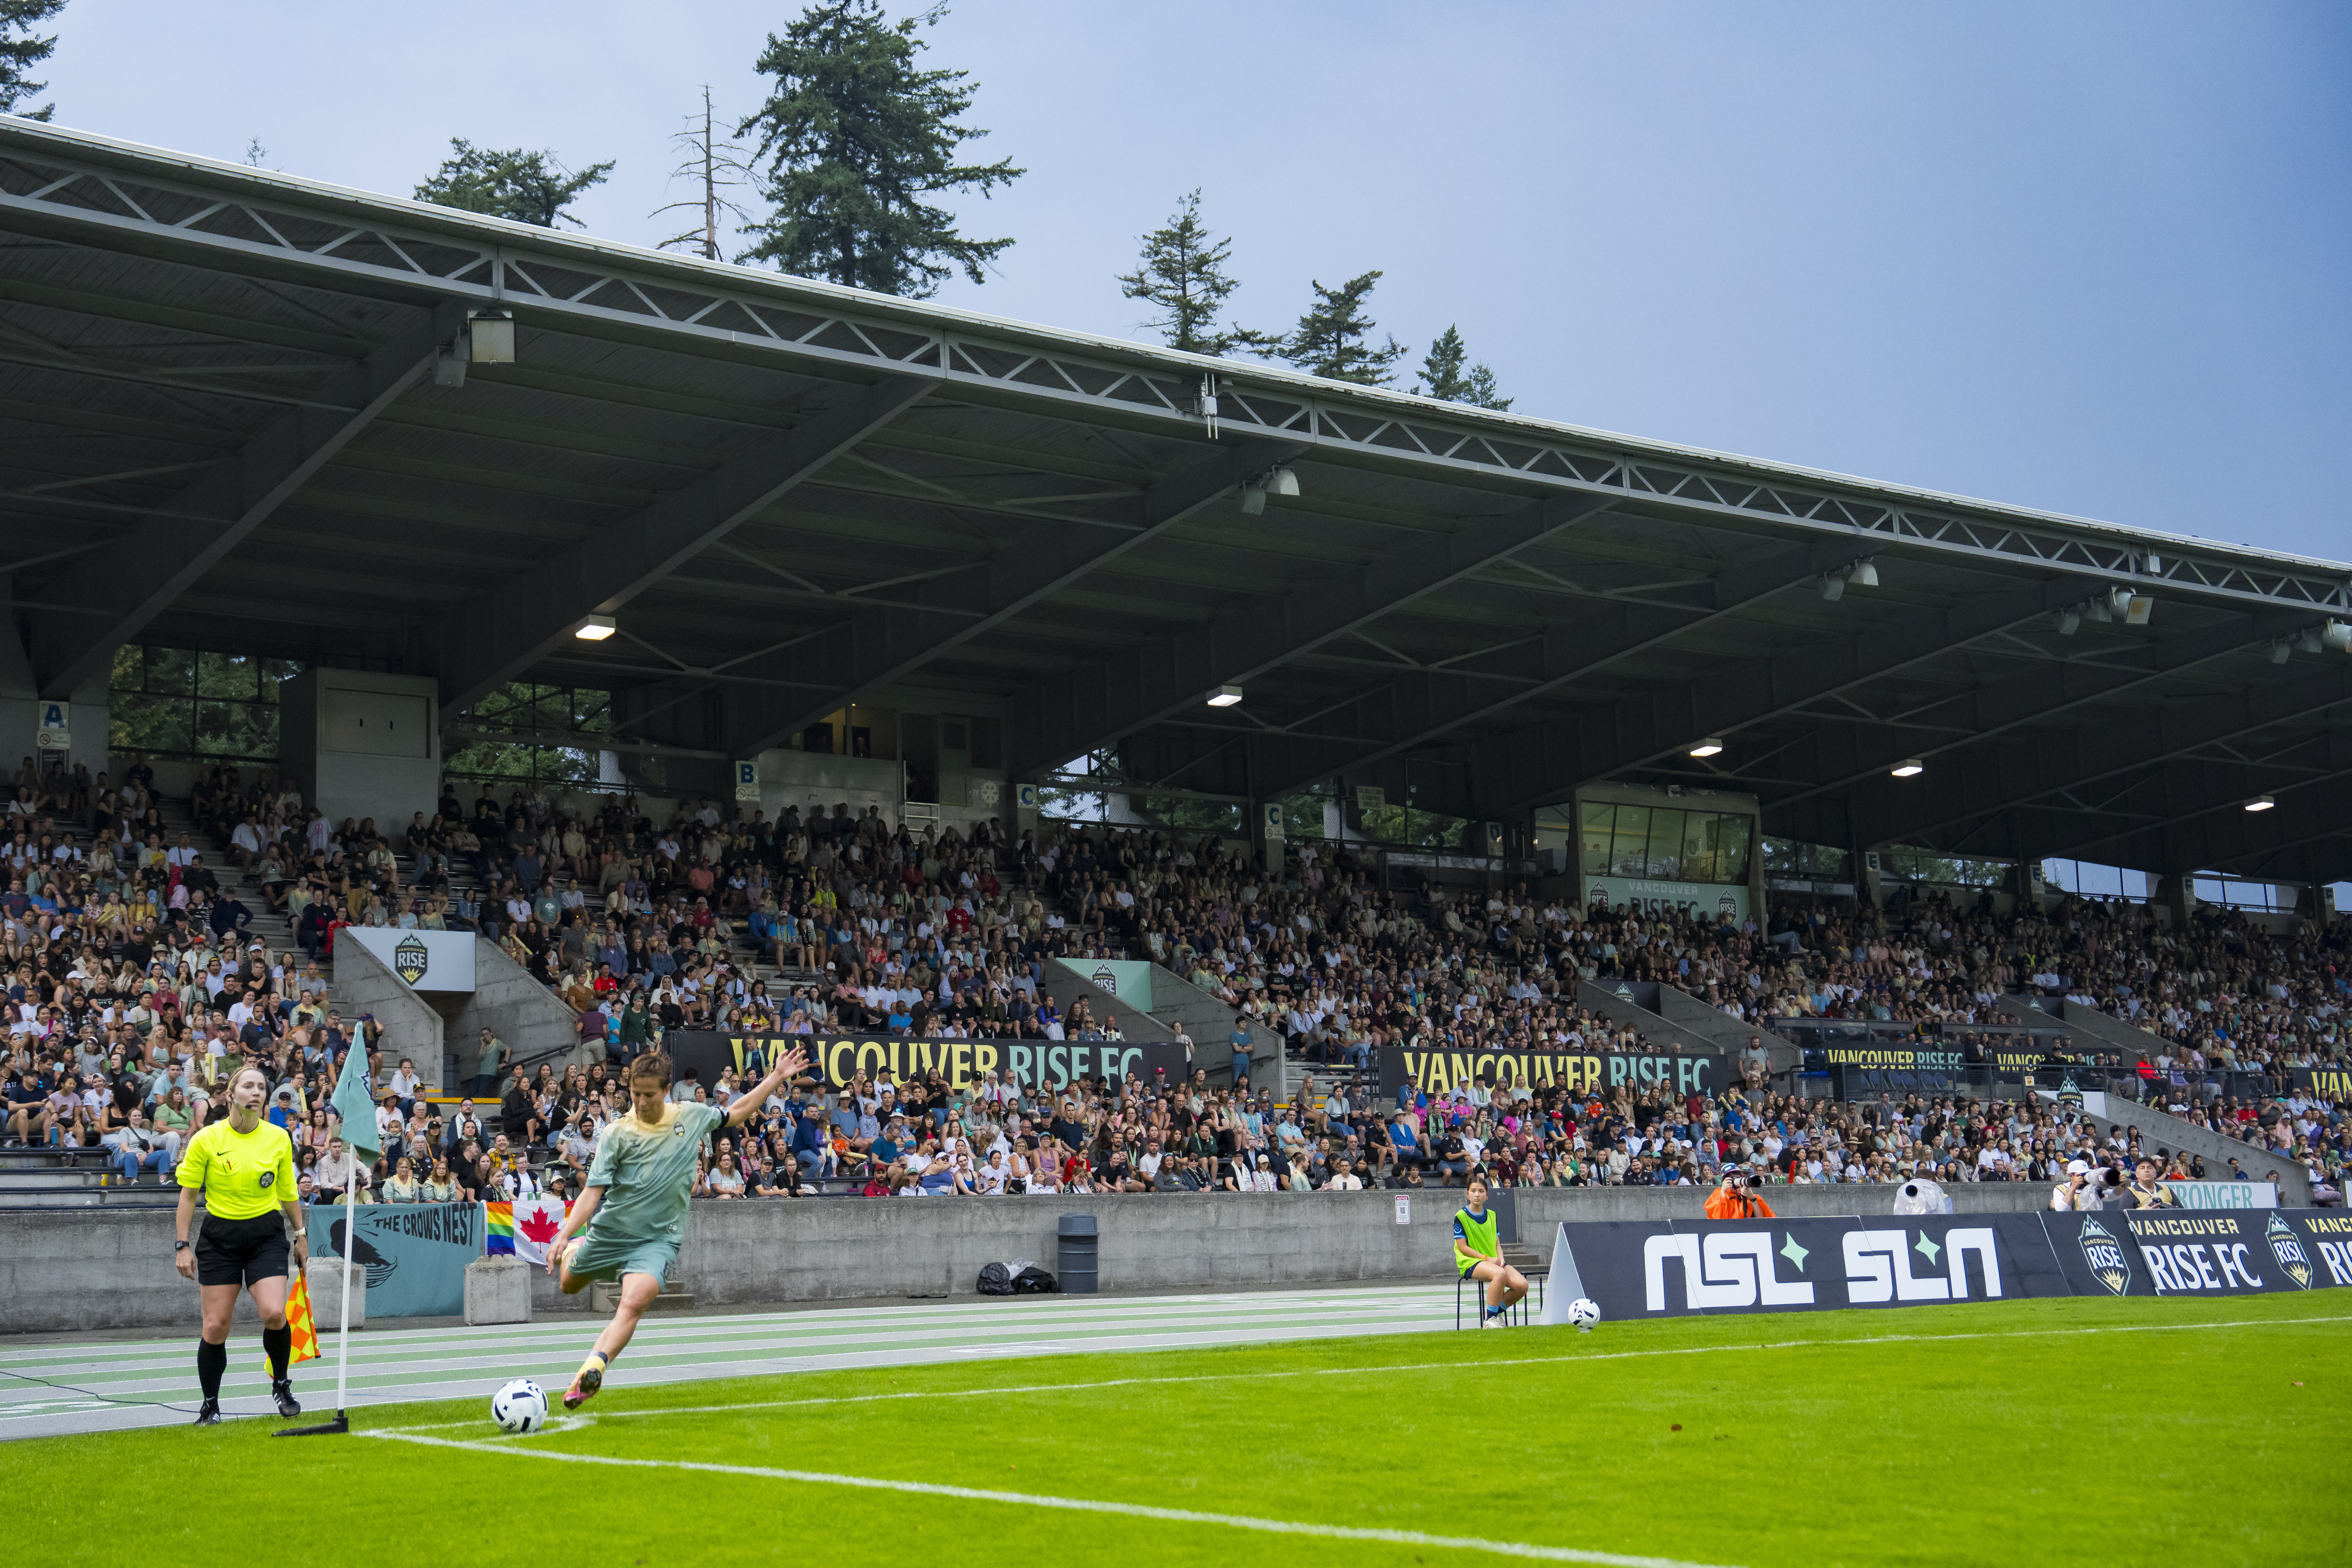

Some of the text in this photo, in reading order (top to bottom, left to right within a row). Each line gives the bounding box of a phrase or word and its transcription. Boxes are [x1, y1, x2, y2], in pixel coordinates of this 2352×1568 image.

[43, 704, 65, 728] A
[740, 764, 754, 783] B
[1021, 787, 1034, 805] C
[1269, 807, 1280, 825] C
[1869, 854, 1877, 870] E
[2032, 867, 2041, 882] E
[1628, 881, 1699, 895] VANCOUVER
[2185, 879, 2193, 892] F
[1720, 903, 1736, 914] RISE
[397, 952, 425, 968] RISE
[1828, 1049, 1963, 1071] VANCOUVER RISE FC
[1009, 1045, 1090, 1095] RISE
[1100, 1047, 1144, 1091] FC
[1404, 1052, 1711, 1096] VANCOUVER RISE FC
[2170, 1183, 2254, 1209] RONGER
[373, 1202, 477, 1247] THE CROWS NEST
[2130, 1219, 2240, 1236] VANCOUVER
[2304, 1218, 2352, 1233] VANC
[2086, 1245, 2125, 1269] RISE
[2317, 1241, 2352, 1285] RI
[2140, 1243, 2264, 1290] RISE FC
